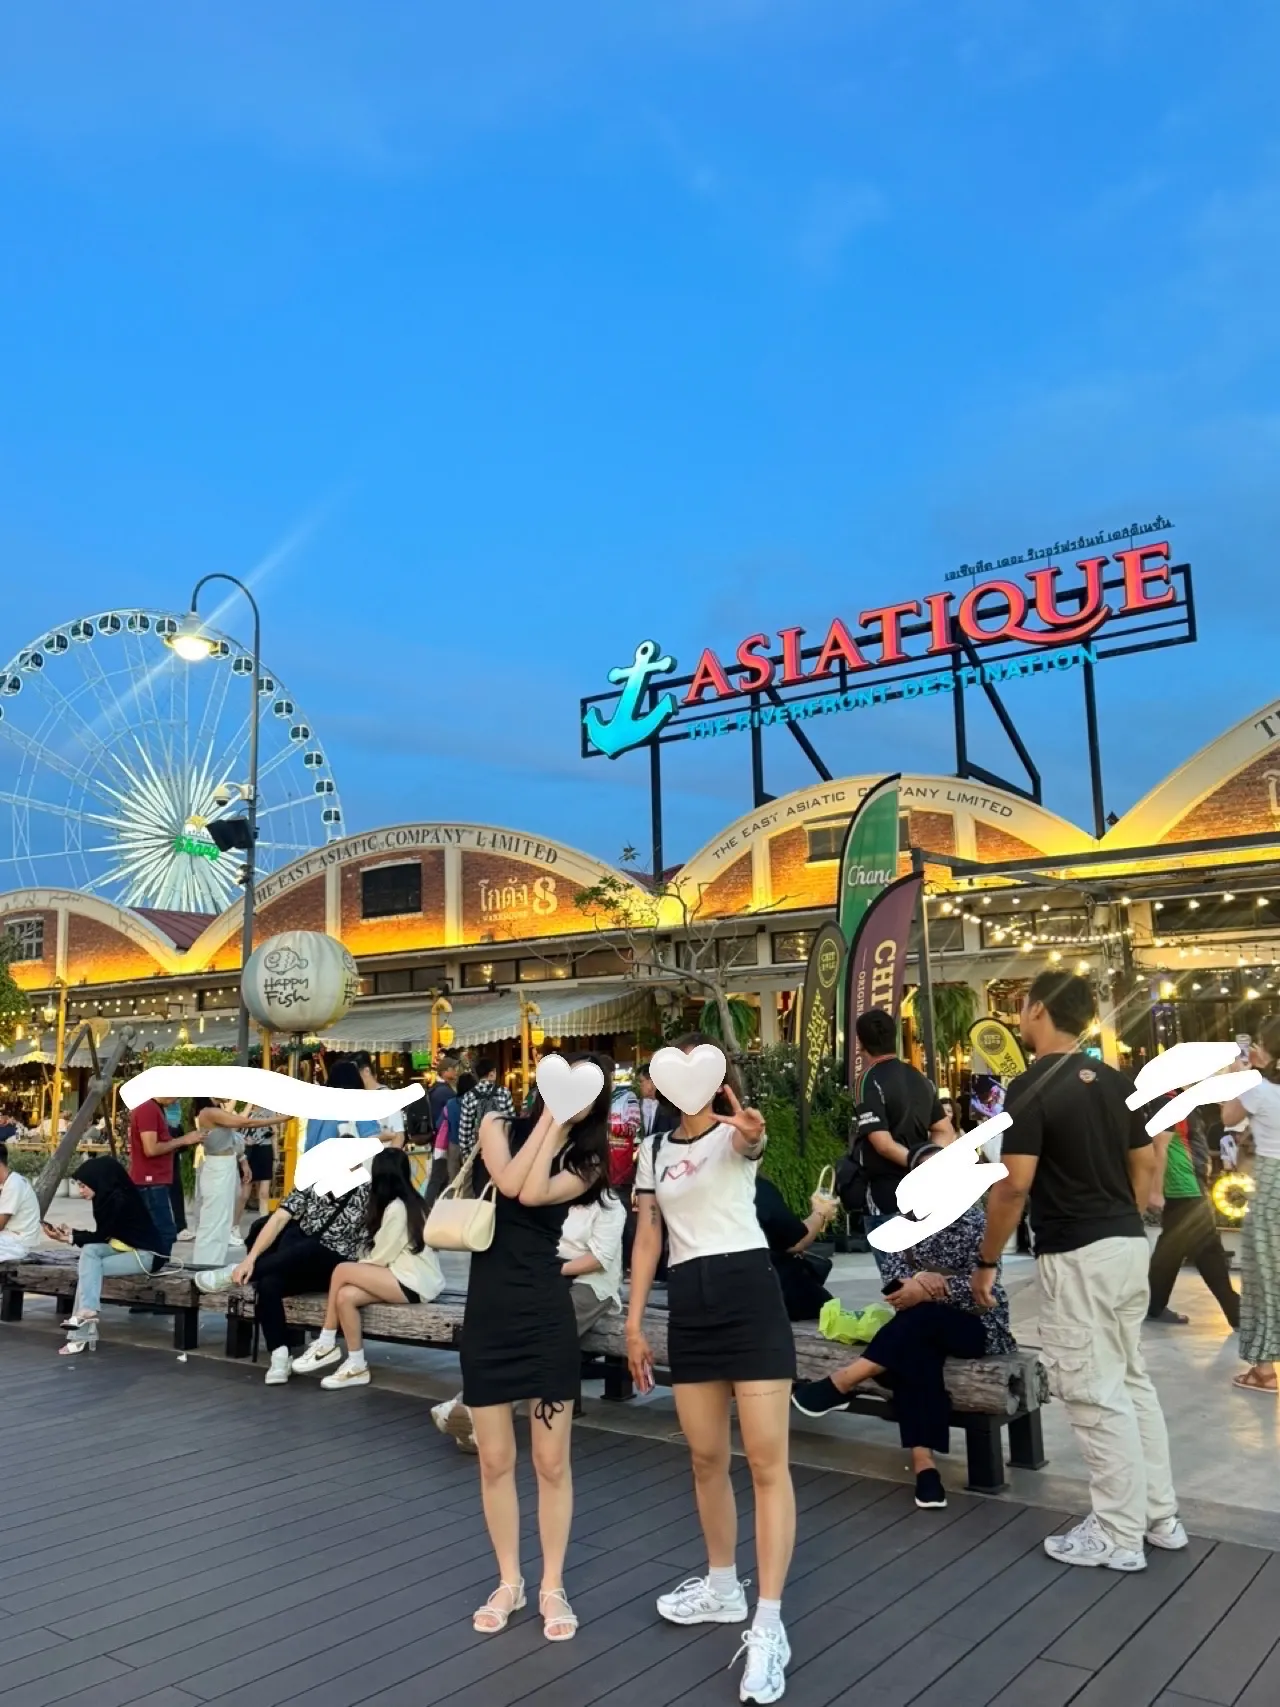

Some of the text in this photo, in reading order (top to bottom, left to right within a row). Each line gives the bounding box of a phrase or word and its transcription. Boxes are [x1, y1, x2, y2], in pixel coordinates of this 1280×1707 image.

[682, 541, 1177, 705] ASIATIQUE
[686, 643, 1099, 740] THE RIVERFRONT DESTINATION
[712, 786, 1013, 861] THE EAST ASIATIC CPANY LIMITED
[278, 862, 311, 889] EAST
[318, 834, 378, 869] ASIATIC
[385, 828, 463, 849] COMPANY
[476, 831, 559, 865] LIMITED
[532, 876, 558, 916] 8
[264, 989, 310, 1008] Fish
